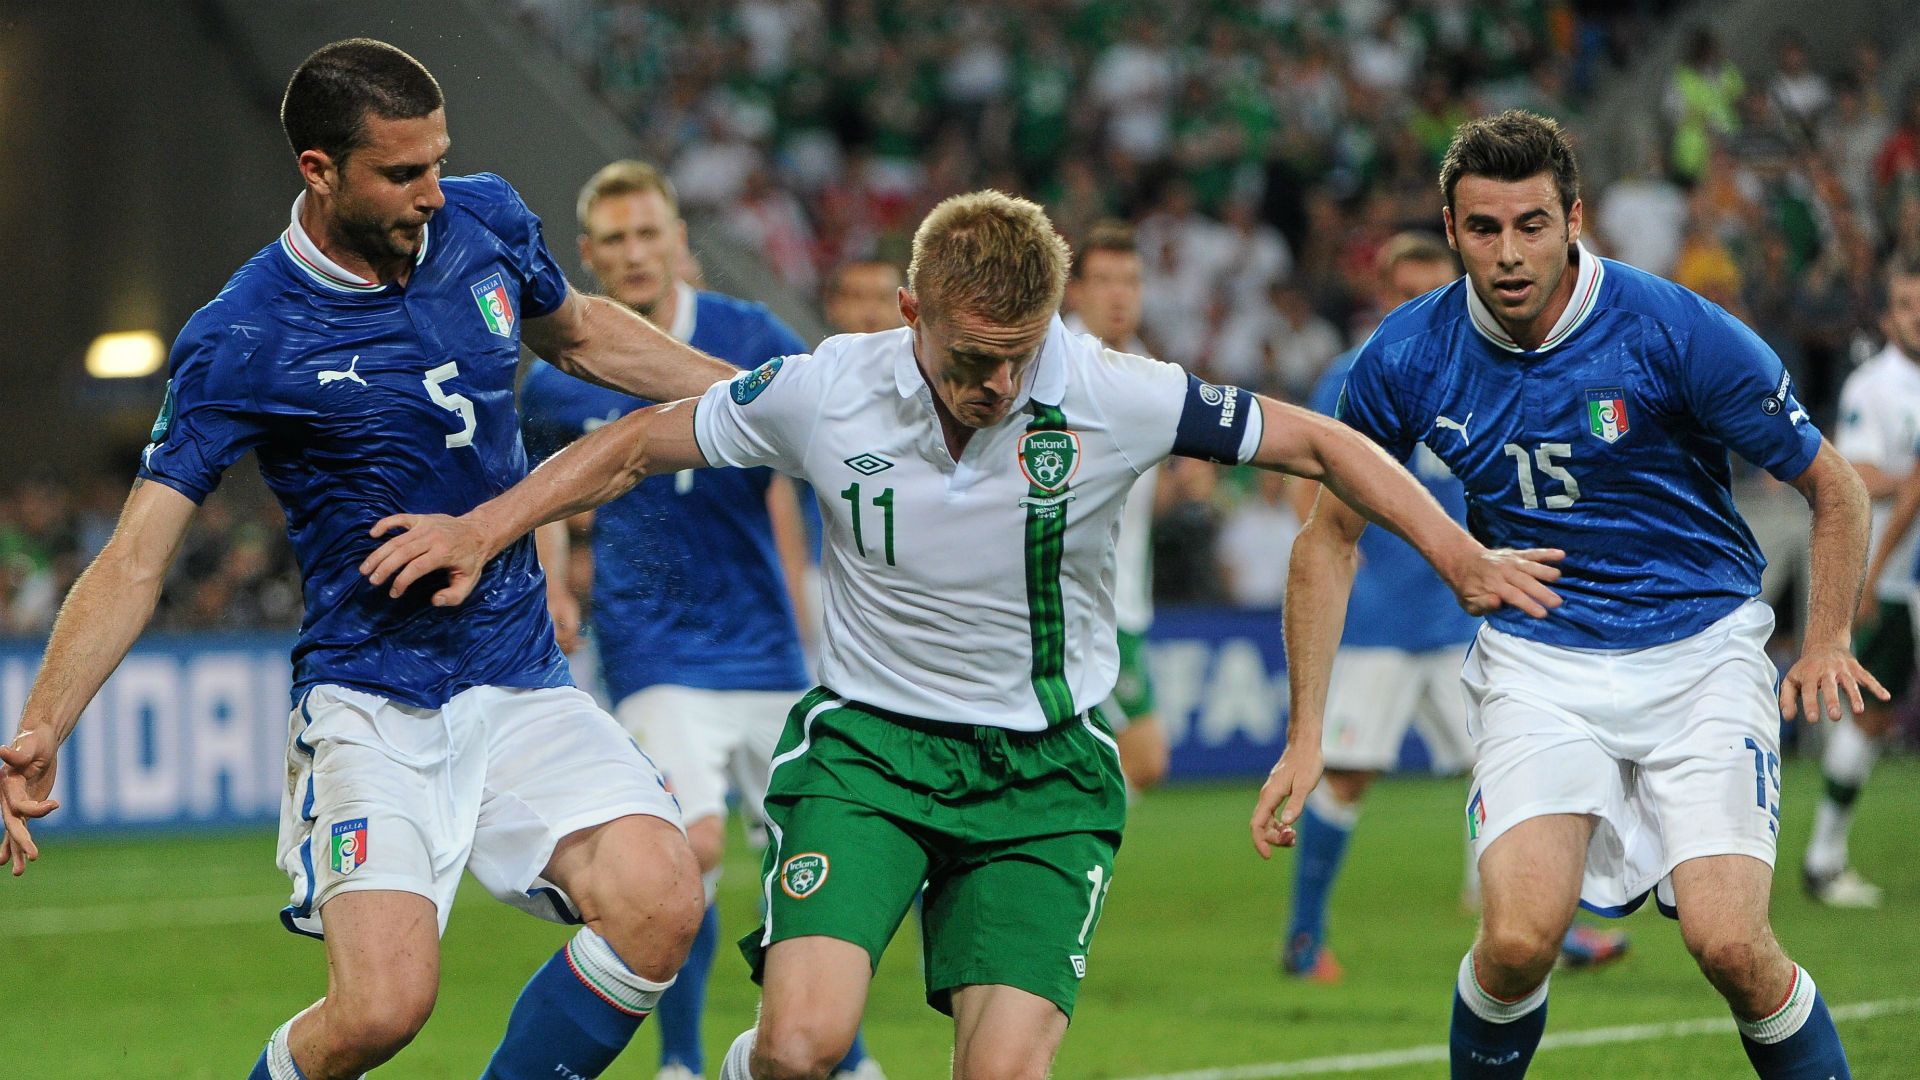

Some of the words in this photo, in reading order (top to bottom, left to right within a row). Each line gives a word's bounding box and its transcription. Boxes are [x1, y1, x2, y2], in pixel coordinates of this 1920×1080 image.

[476, 280, 499, 295] ITALIA
[422, 361, 477, 448] 5
[1029, 438, 1067, 449] Ireland
[1504, 443, 1581, 510] 15
[841, 482, 896, 567] 11
[335, 822, 363, 834] ITALIA
[790, 858, 819, 870] Ireland
